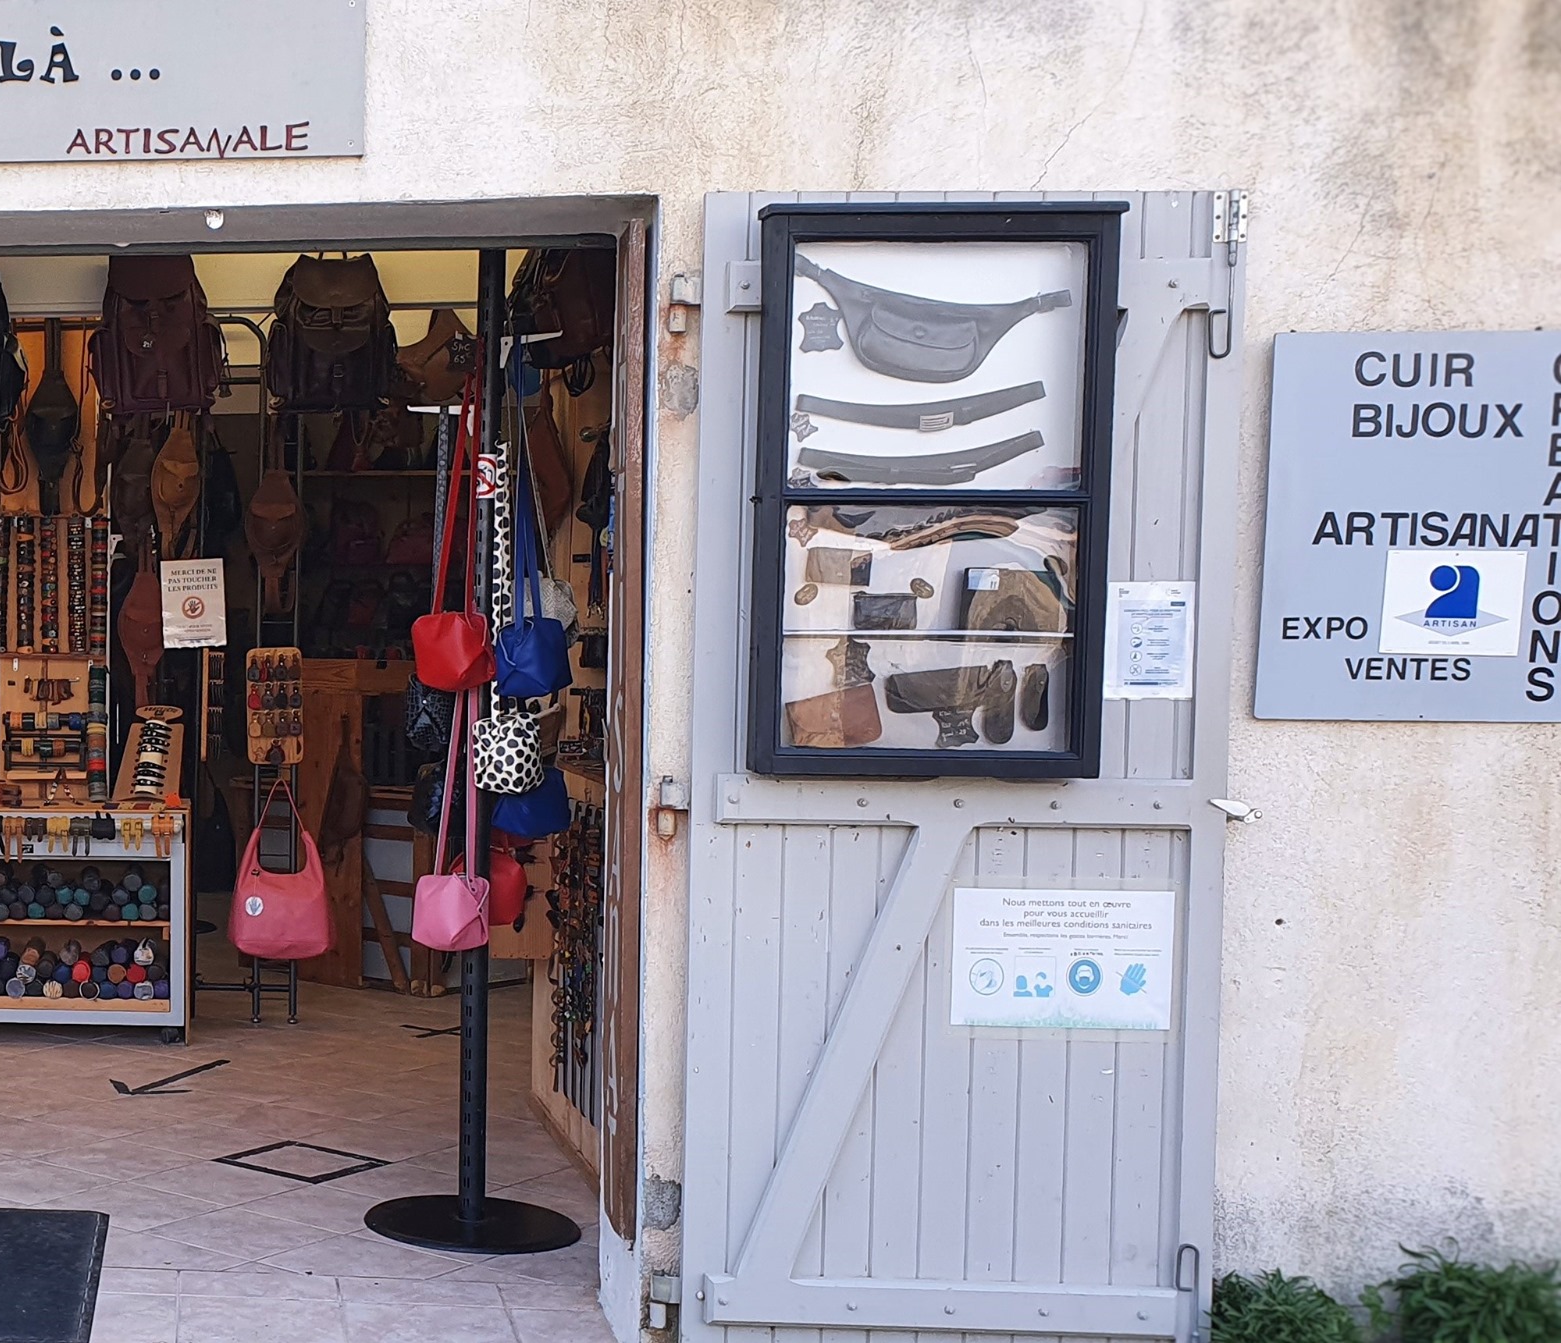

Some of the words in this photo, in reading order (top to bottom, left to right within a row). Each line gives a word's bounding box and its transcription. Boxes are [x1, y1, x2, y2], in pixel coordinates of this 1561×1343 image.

[66, 121, 310, 163] ARTISANALE
[1354, 351, 1475, 388] CUIR
[1351, 402, 1524, 439] BIJOUX
[1282, 616, 1368, 640] EXPO
[1423, 619, 1477, 628] ARTISAN
[1344, 657, 1471, 682] VENTES
[1002, 898, 1026, 907] Nous
[1029, 899, 1064, 907] mettons
[1068, 900, 1086, 908] tout
[1070, 911, 1109, 919] accueillir
[979, 919, 999, 927] dans
[1002, 919, 1014, 927] les
[1016, 920, 1060, 928] meilleures
[1064, 920, 1109, 929] conditions
[1112, 922, 1152, 930] sanitaires
